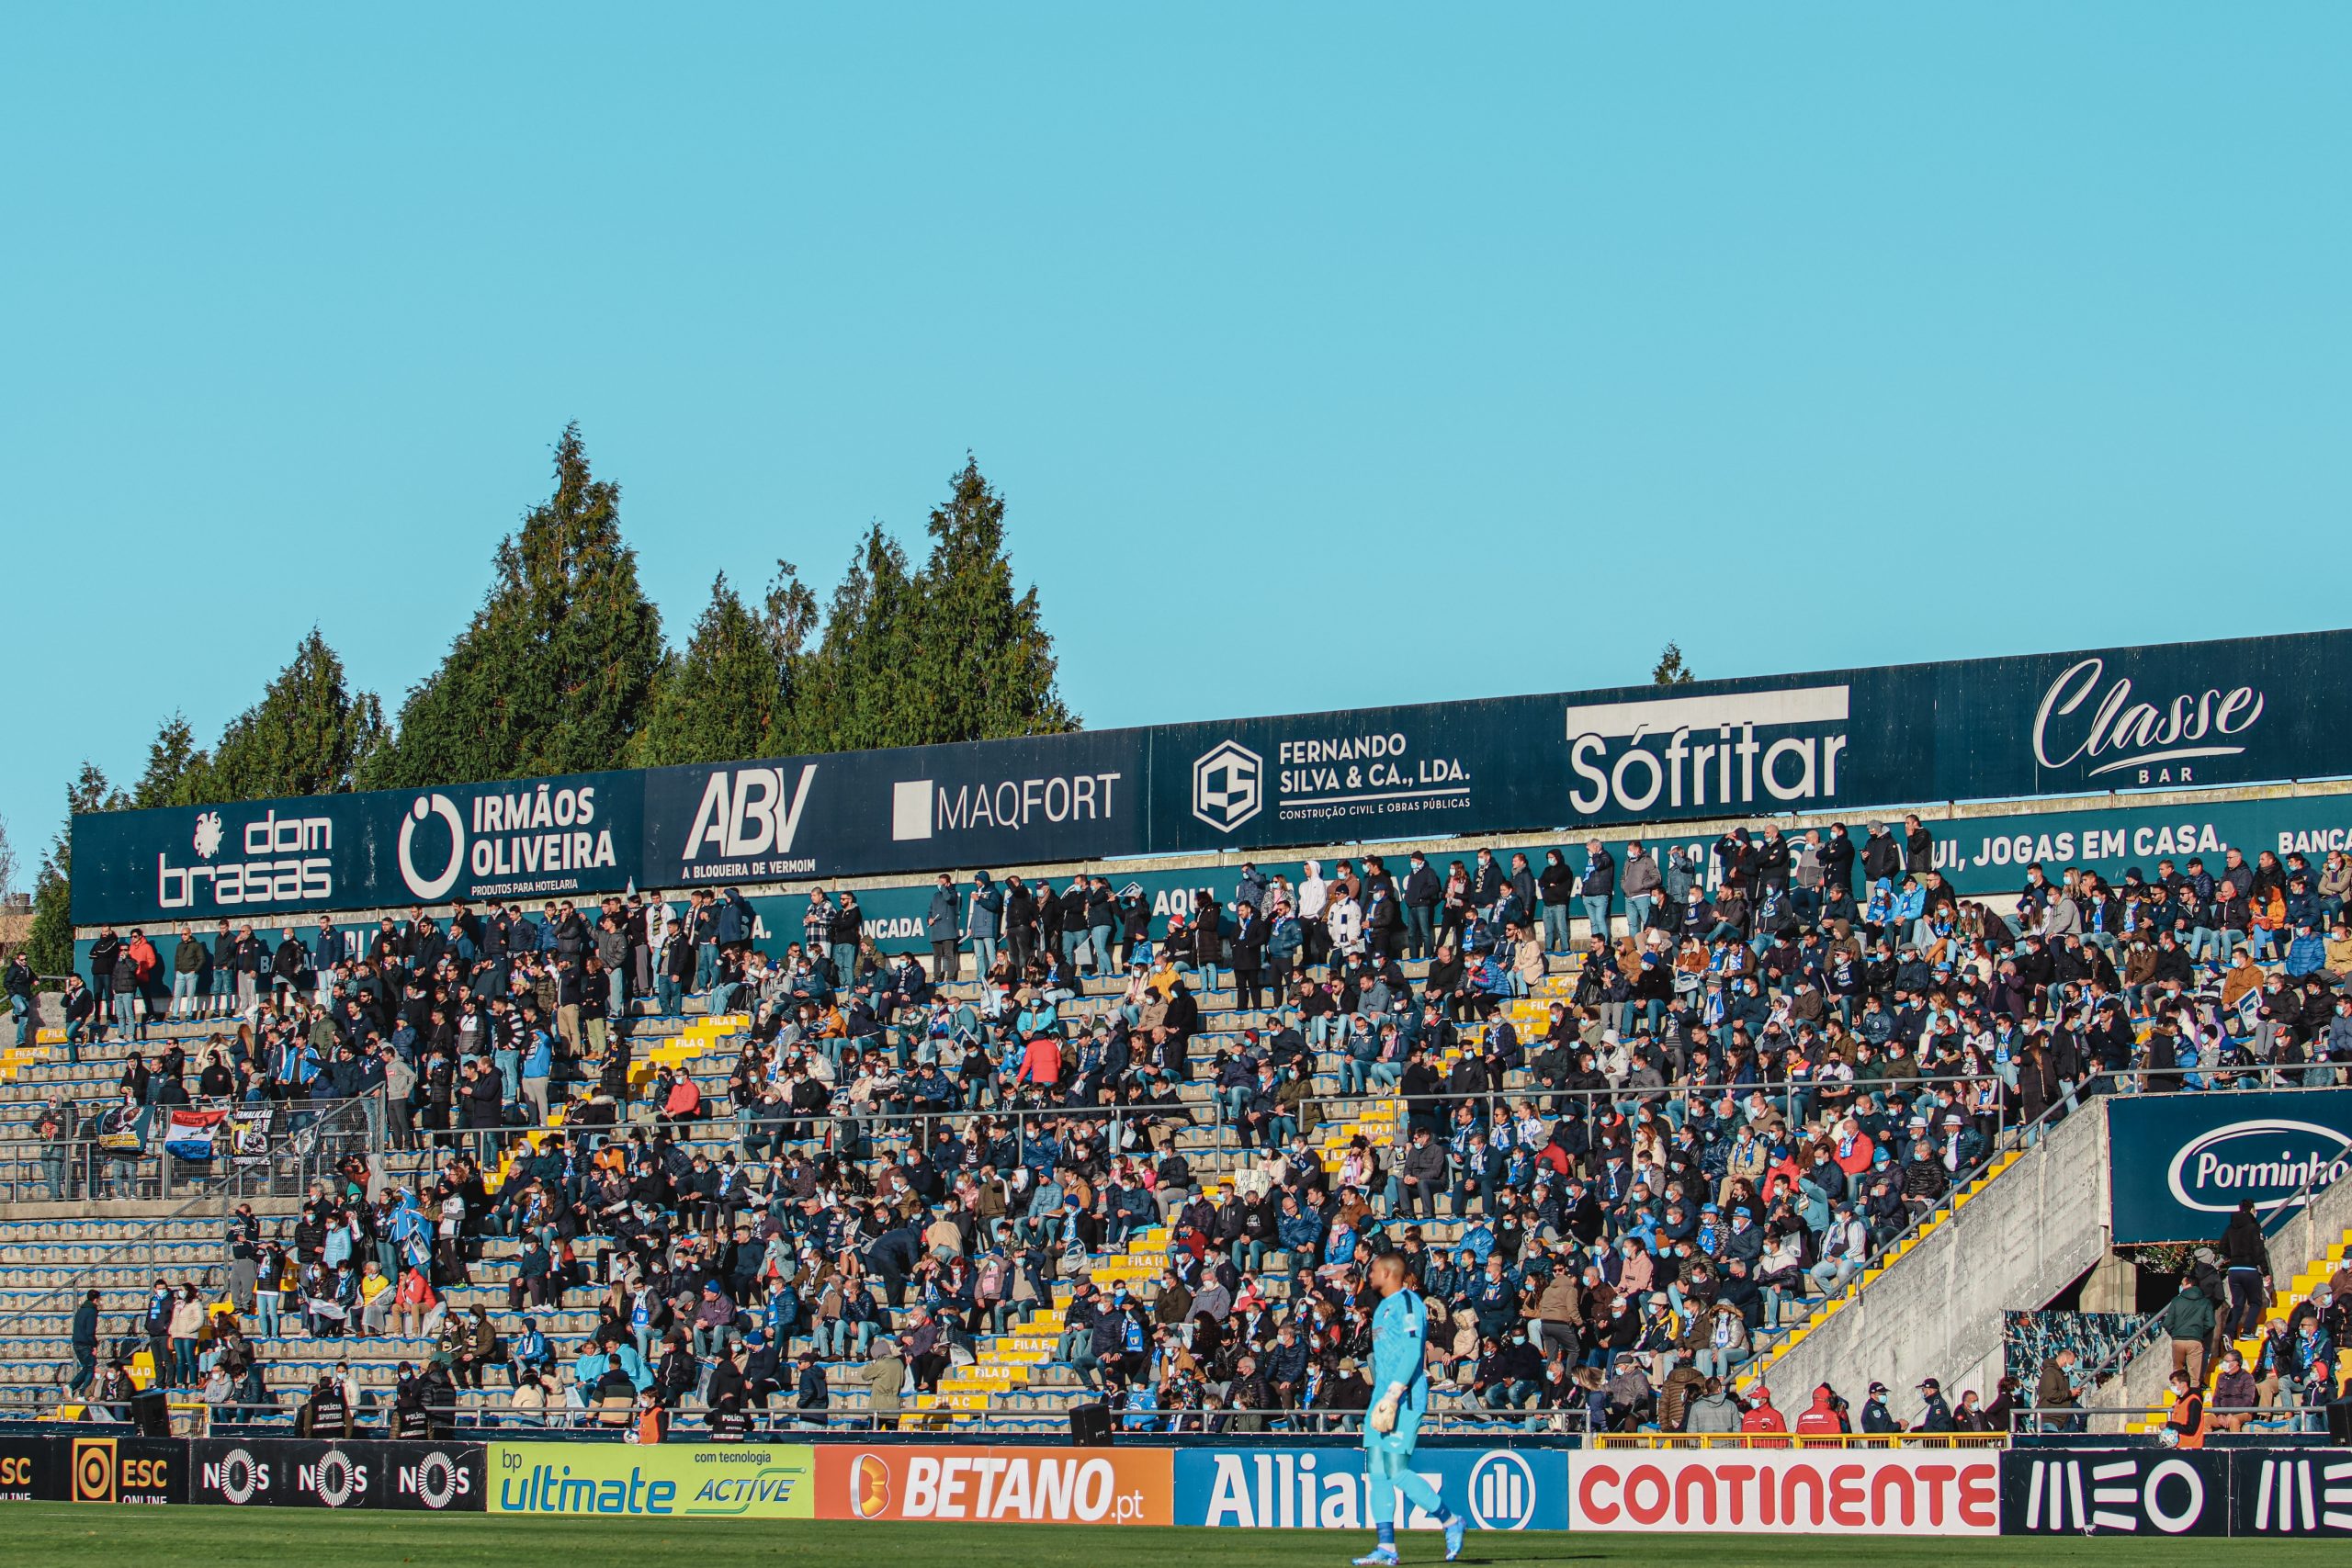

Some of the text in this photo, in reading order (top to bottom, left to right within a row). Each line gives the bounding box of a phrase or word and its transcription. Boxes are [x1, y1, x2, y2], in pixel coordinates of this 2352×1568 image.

[2033, 658, 2264, 769] Classe
[1281, 733, 1406, 765] FERNANDO
[1281, 759, 1470, 793] SILVA & CA., LDA.
[2139, 766, 2193, 784] BAR
[473, 784, 594, 832] IRMÃOS
[683, 764, 817, 861] ABV
[938, 773, 1121, 830] MAQFORT
[1279, 797, 1470, 819] CONSTRUÇÃO CIVIL E OBRAS PÚBLICAS
[245, 810, 333, 854] dom
[1973, 832, 2074, 866] JOGAS
[2082, 829, 2126, 859] EM
[2133, 824, 2227, 855] CASA.
[472, 829, 616, 876] OLIVEIRA
[159, 852, 332, 908] brasas
[682, 858, 816, 879] A BLOQUEIRA DE VERMOIM
[471, 879, 579, 896] PRODUTOS PARA HOTELARIA
[676, 1039, 695, 1047] FILA
[1360, 1123, 1383, 1135] FILA
[2196, 1151, 2350, 1189] Porminho
[1128, 1256, 1152, 1266] FILA
[1014, 1340, 1039, 1349] FILA
[975, 1368, 1010, 1378] FILA D
[318, 1402, 342, 1412] POLÍCIA
[934, 1396, 970, 1407] FILA C
[405, 1411, 425, 1421] POLÍCIA
[0, 1458, 31, 1484] SC
[503, 1449, 523, 1472] bp
[695, 1450, 771, 1466] com tecnologia
[122, 1460, 167, 1488] ESC
[204, 1449, 269, 1505] NOS
[299, 1450, 367, 1506] NOS
[400, 1451, 469, 1509] NOS
[501, 1464, 676, 1514] ultimate
[695, 1479, 797, 1502] ACTIVE
[1578, 1463, 1996, 1528] CONTINENTE
